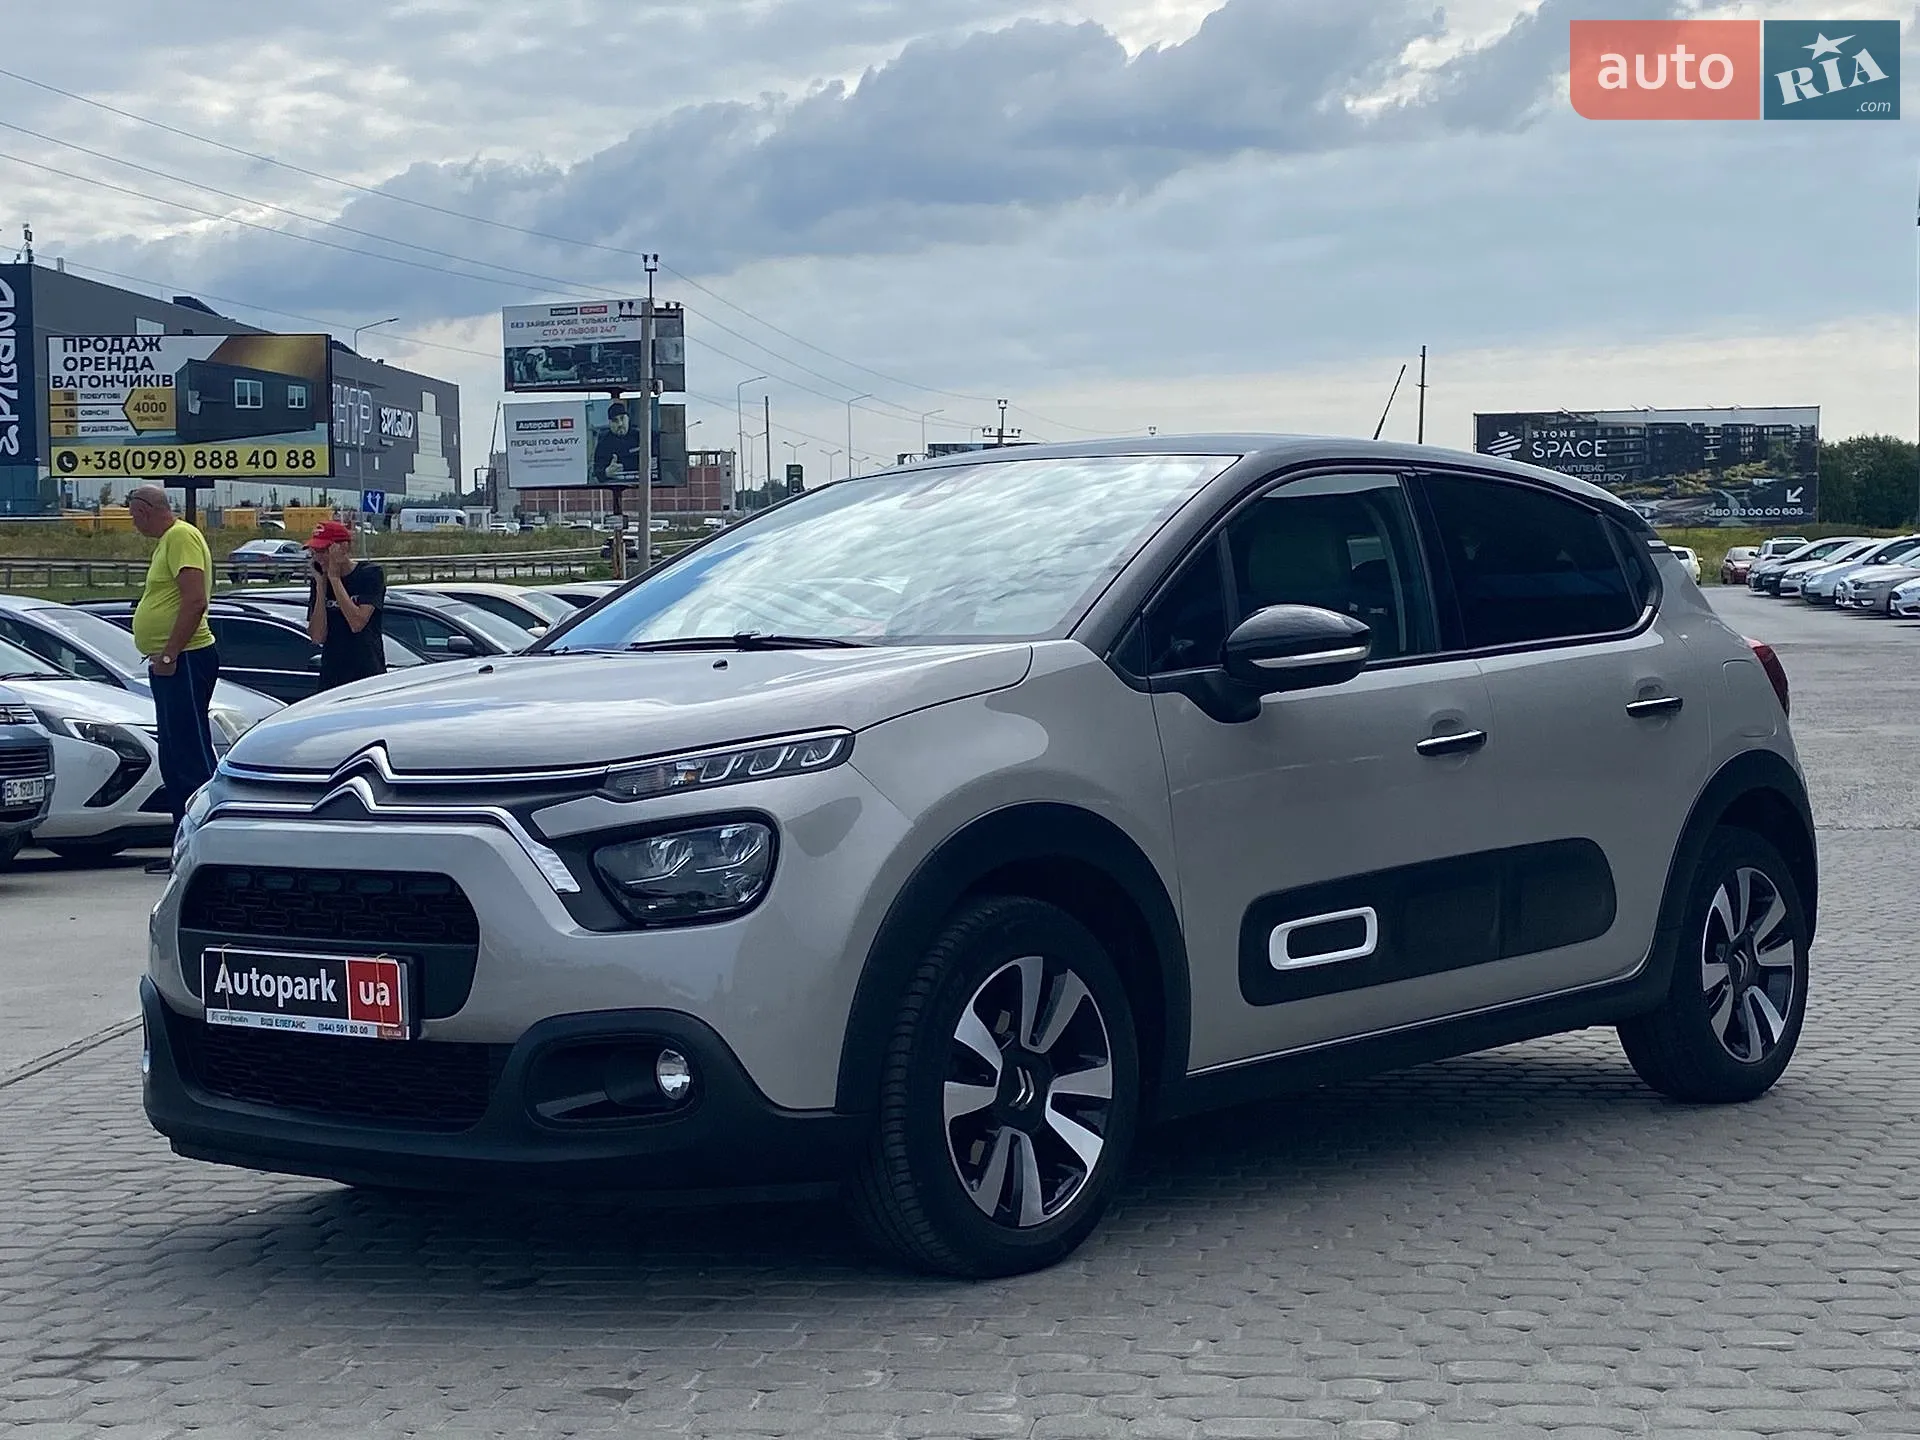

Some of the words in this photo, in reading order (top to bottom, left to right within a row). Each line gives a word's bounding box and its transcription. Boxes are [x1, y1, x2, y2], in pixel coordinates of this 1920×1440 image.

[63, 336, 161, 355] ПРОДАЖ
[63, 356, 154, 373] ОРЕНДА
[52, 374, 173, 388] ВАГОНЧИКІВ
[80, 392, 121, 400] ПОБУТОВІ
[133, 402, 167, 413] 4000
[518, 421, 557, 430] Autopark
[1532, 430, 1576, 438] STONE
[511, 439, 537, 447] ПЕРШІ
[553, 437, 579, 445] ФАКТУ
[1532, 440, 1607, 458] SPACE
[81, 449, 185, 474] +38(098)
[194, 450, 239, 470] 888
[246, 449, 277, 469] 40
[286, 449, 317, 469] 88
[214, 963, 337, 1007] Autopark
[359, 981, 390, 1006] ua
[318, 1023, 334, 1033] (044)
[336, 1025, 348, 1035] 591
